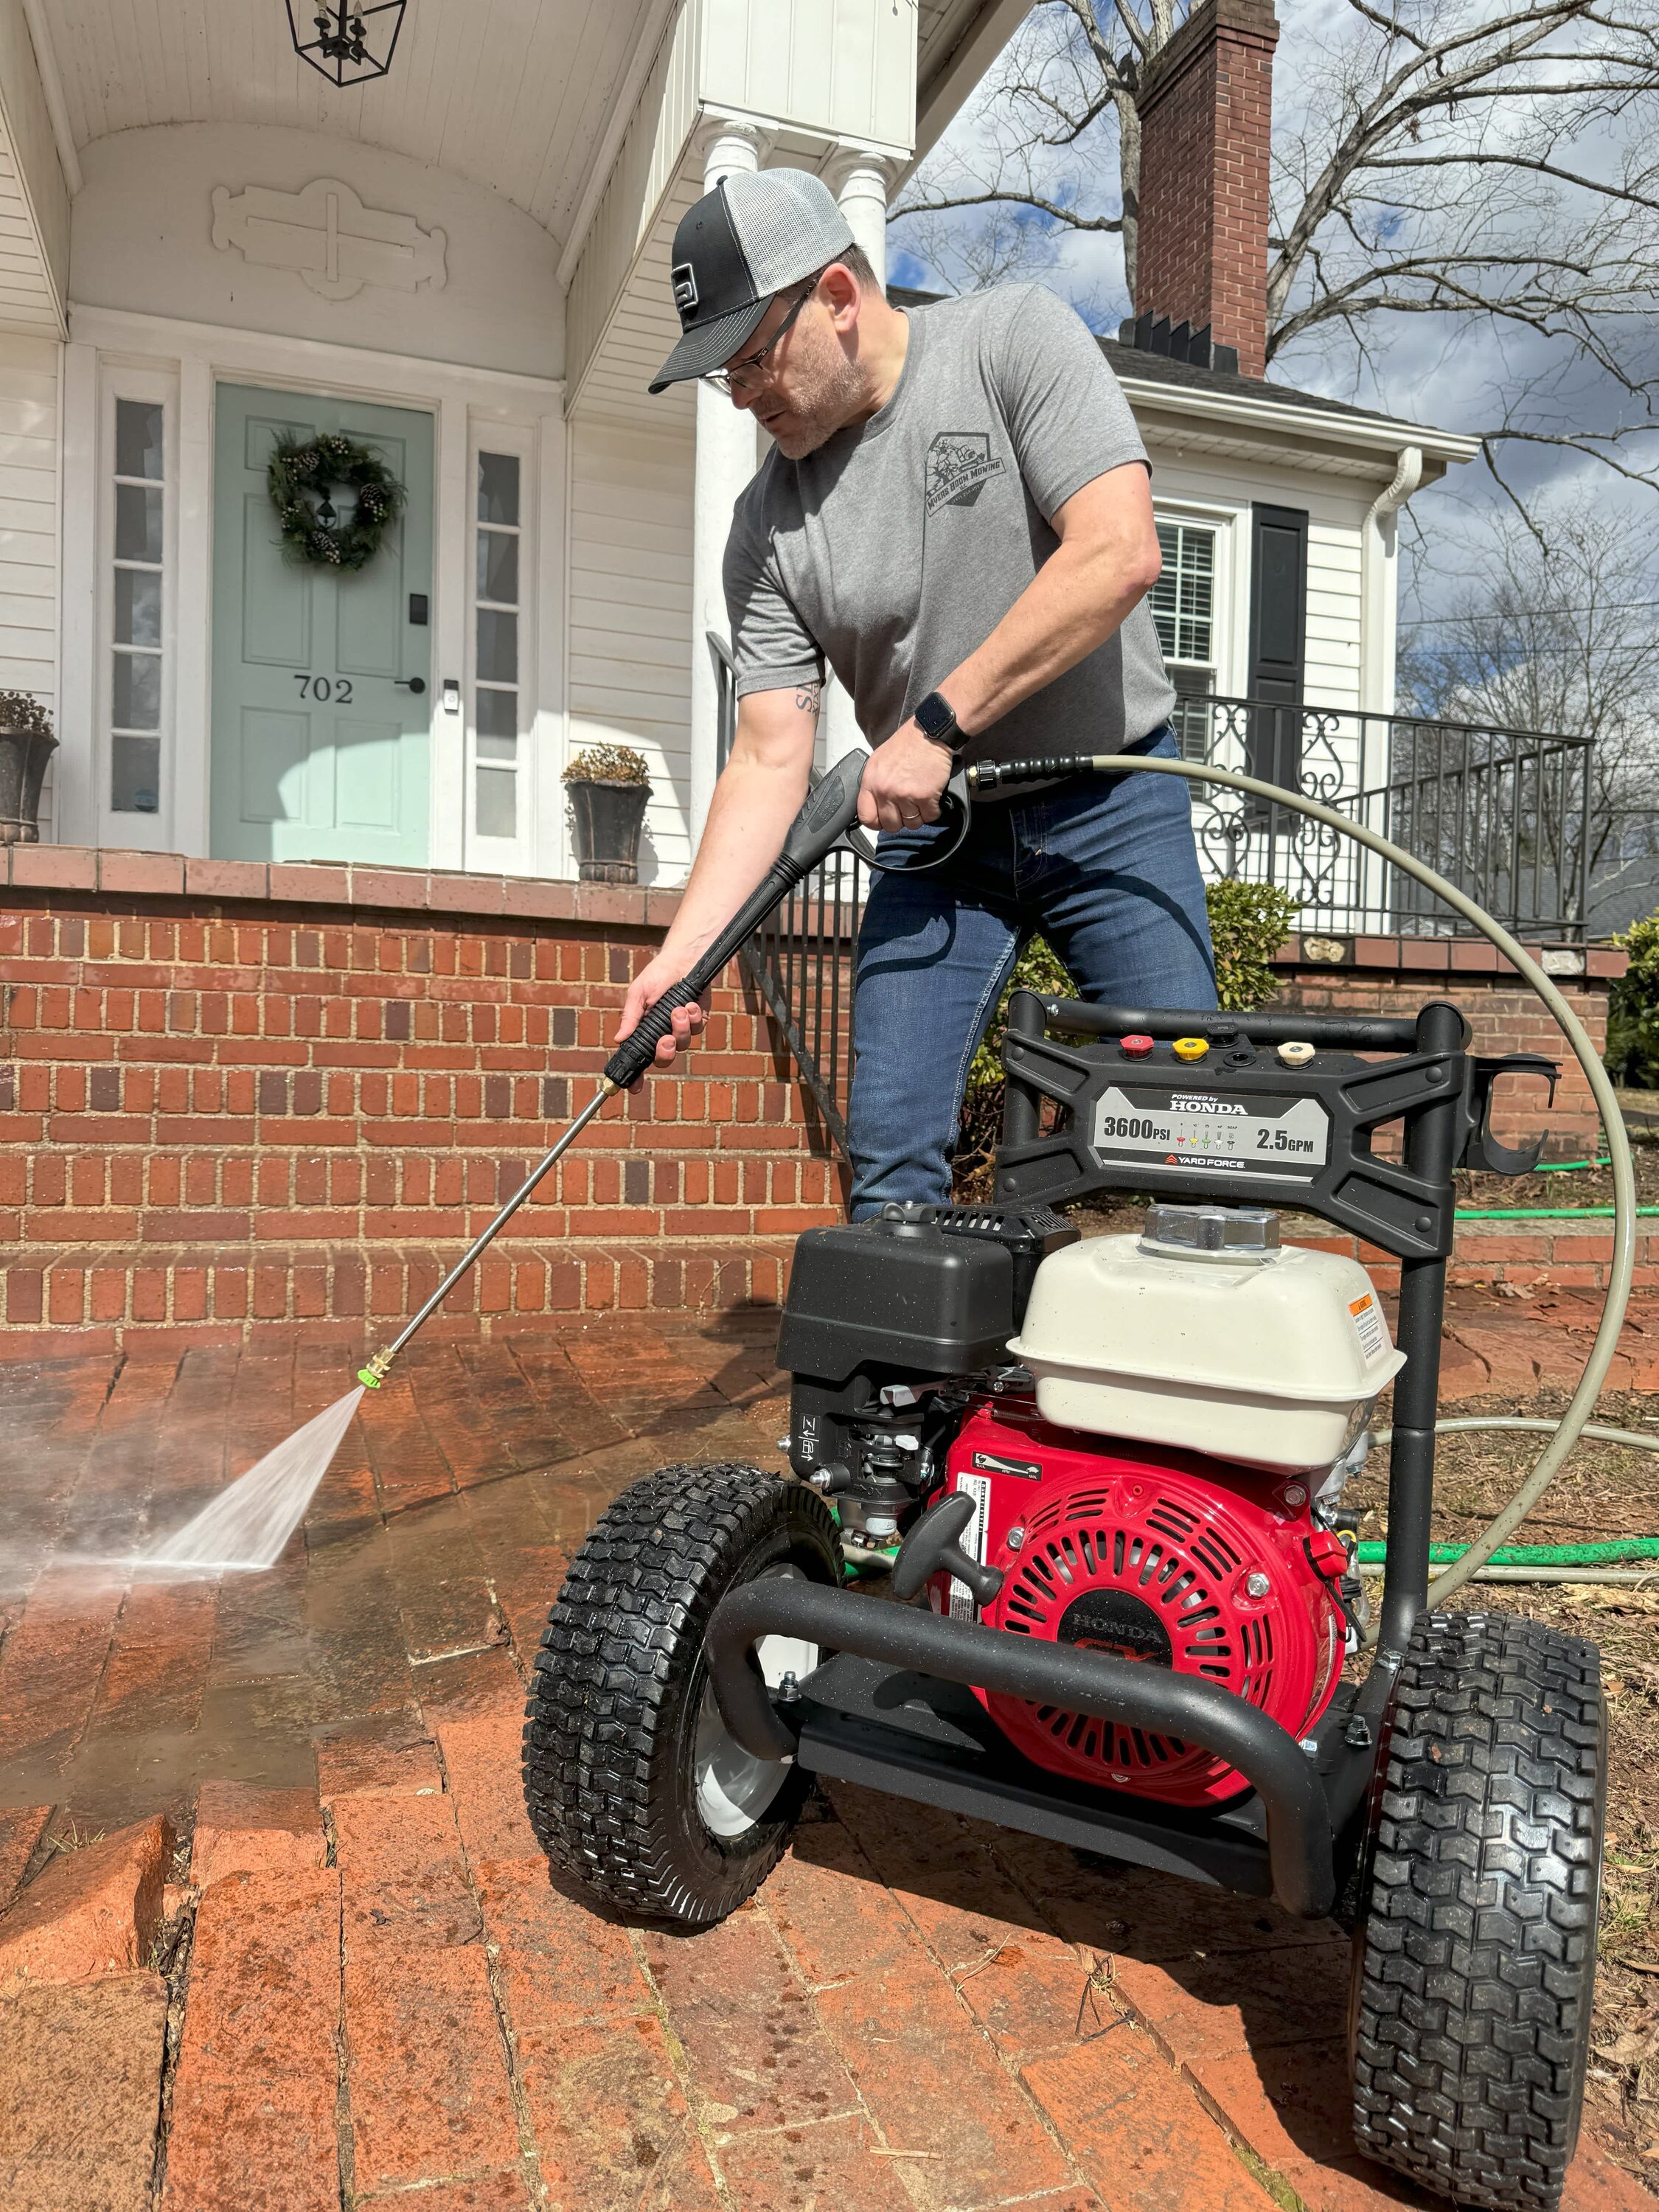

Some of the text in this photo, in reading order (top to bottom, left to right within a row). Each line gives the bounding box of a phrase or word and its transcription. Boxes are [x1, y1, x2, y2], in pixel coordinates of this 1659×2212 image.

[927, 488, 949, 510] MYERS
[950, 473, 969, 492] BOOM
[970, 461, 1001, 479] MOWING
[294, 675, 352, 704] 702
[1169, 1100, 1248, 1115] HONDA
[1171, 1093, 1208, 1102] POWERED
[1073, 1613, 1163, 1644] HONDA
